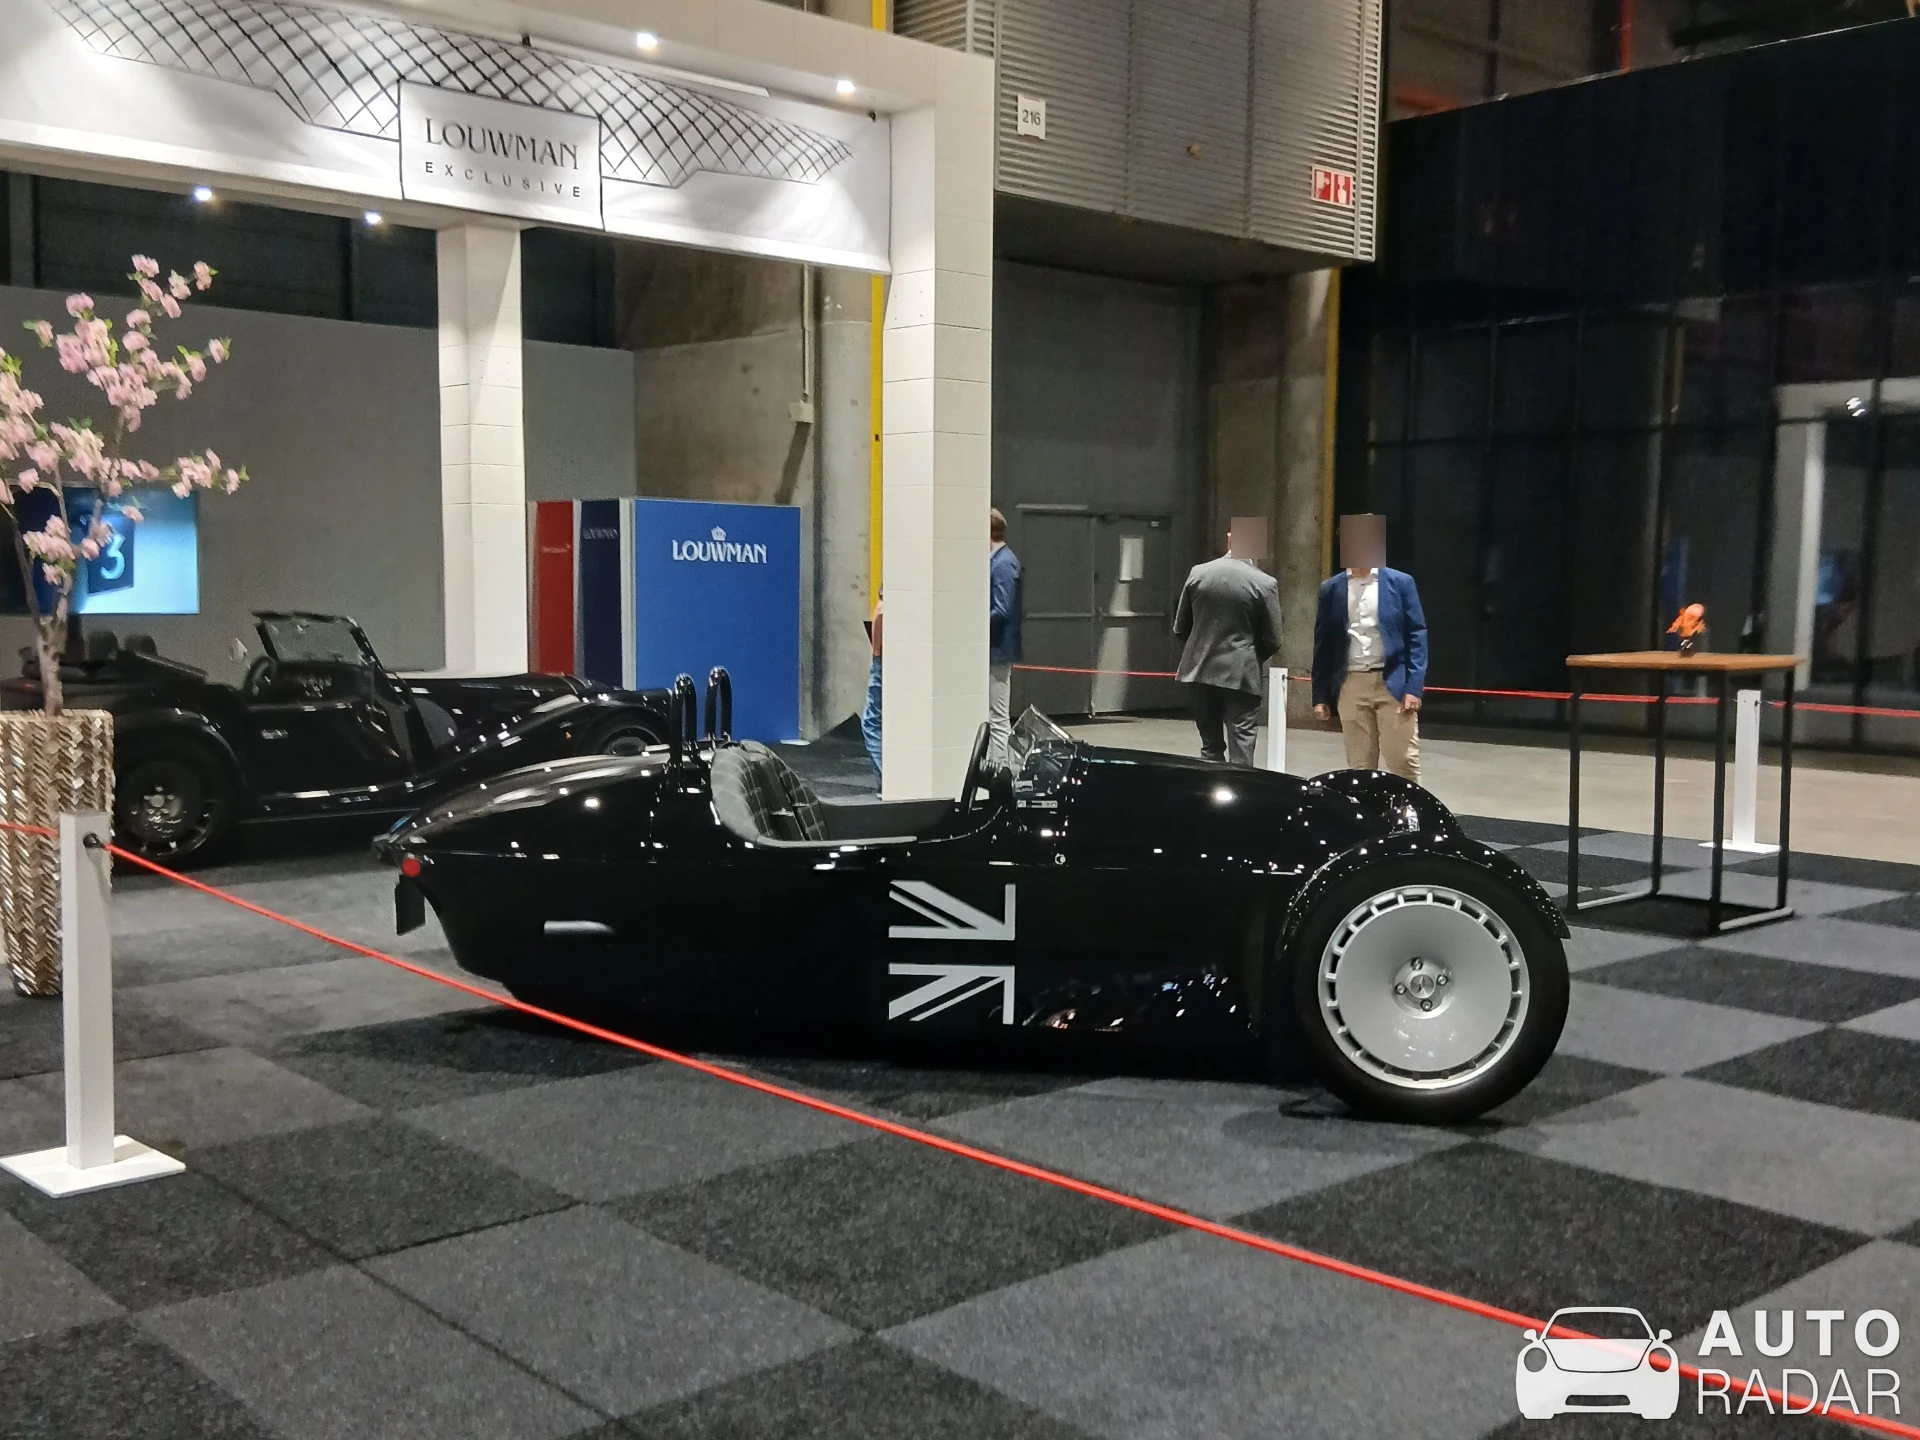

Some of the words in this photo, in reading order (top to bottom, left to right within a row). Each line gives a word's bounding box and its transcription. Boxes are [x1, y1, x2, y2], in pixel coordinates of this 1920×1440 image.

[1022, 109, 1041, 126] 216
[425, 118, 579, 170] LOUWMAN
[425, 161, 580, 198] EXCLUSIVE
[672, 539, 767, 563] LOUWMAN
